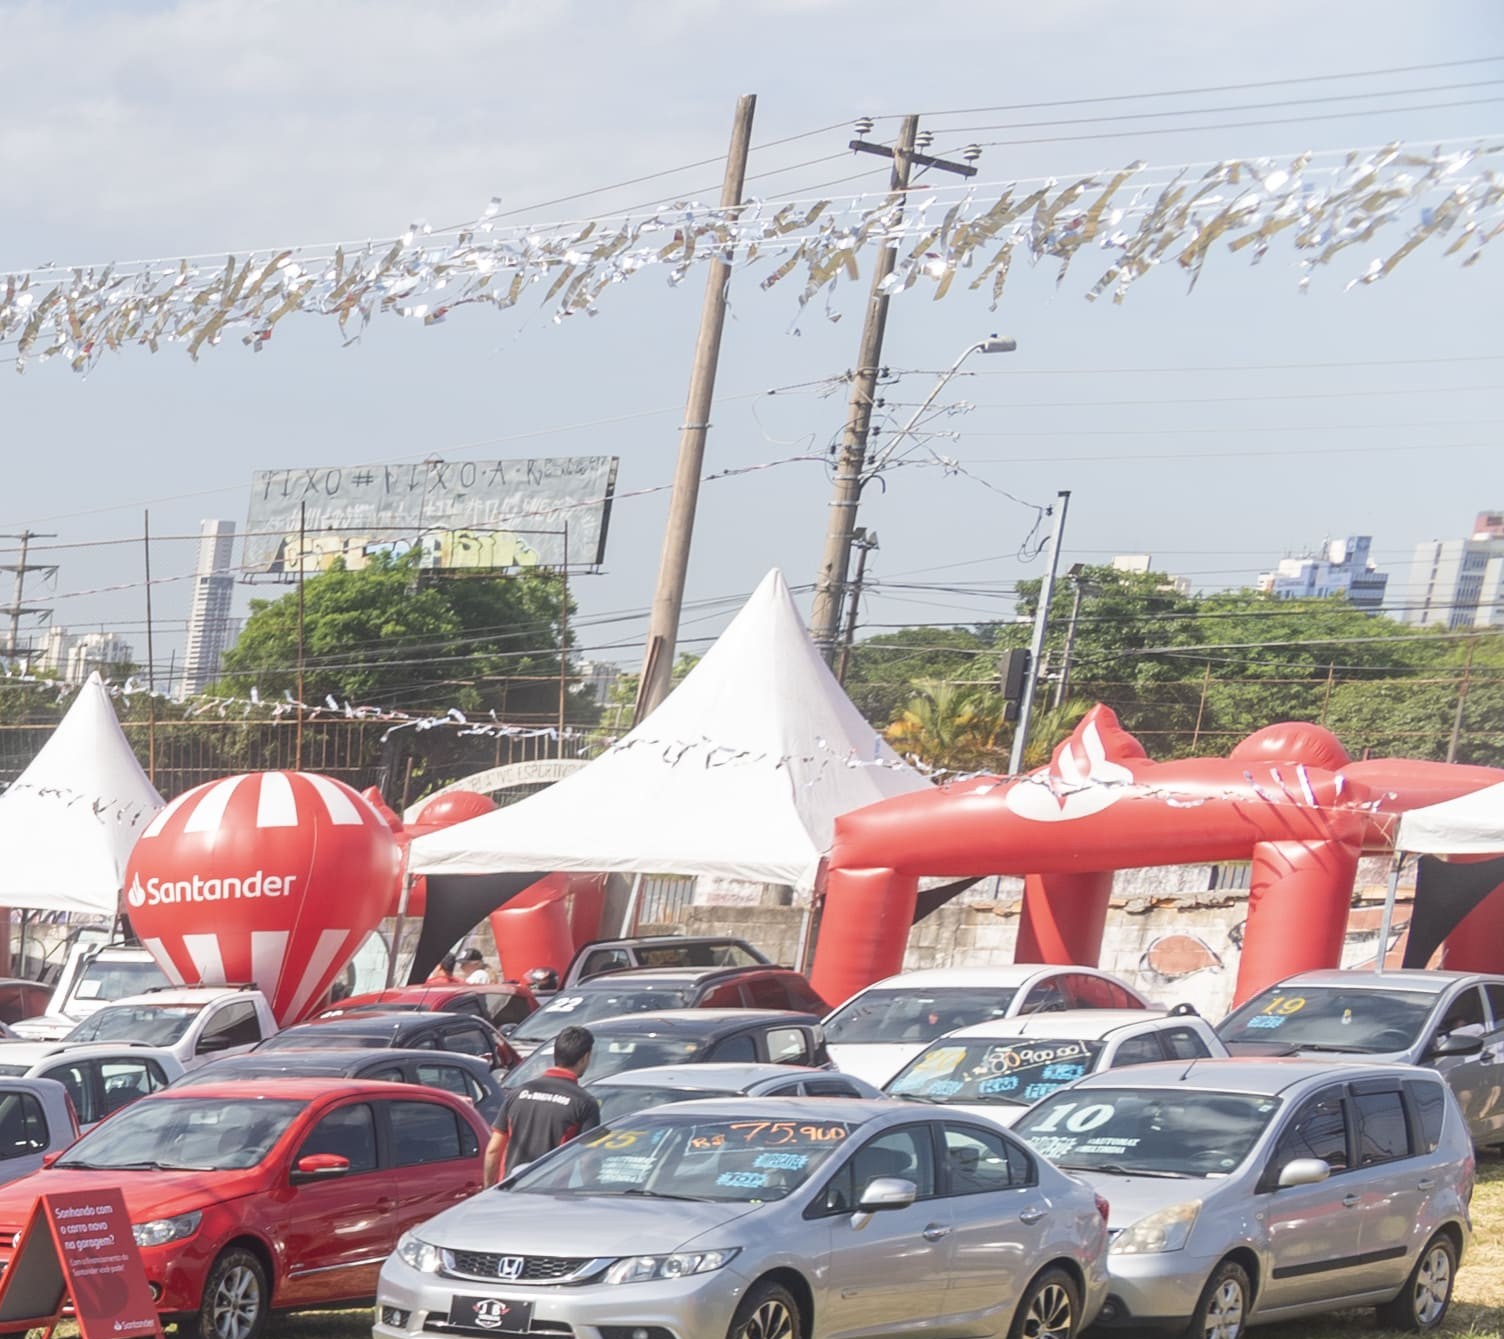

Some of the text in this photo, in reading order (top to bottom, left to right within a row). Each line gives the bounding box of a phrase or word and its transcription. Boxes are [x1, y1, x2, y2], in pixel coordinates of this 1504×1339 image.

[147, 870, 297, 905] Santander
[1262, 996, 1307, 1016] 19
[1031, 1103, 1115, 1132] 10
[55, 1204, 113, 1219] Sonhando com
[60, 1222, 108, 1234] o carro novo
[65, 1234, 115, 1251] na garagem?
[123, 1319, 155, 1330] Santander
